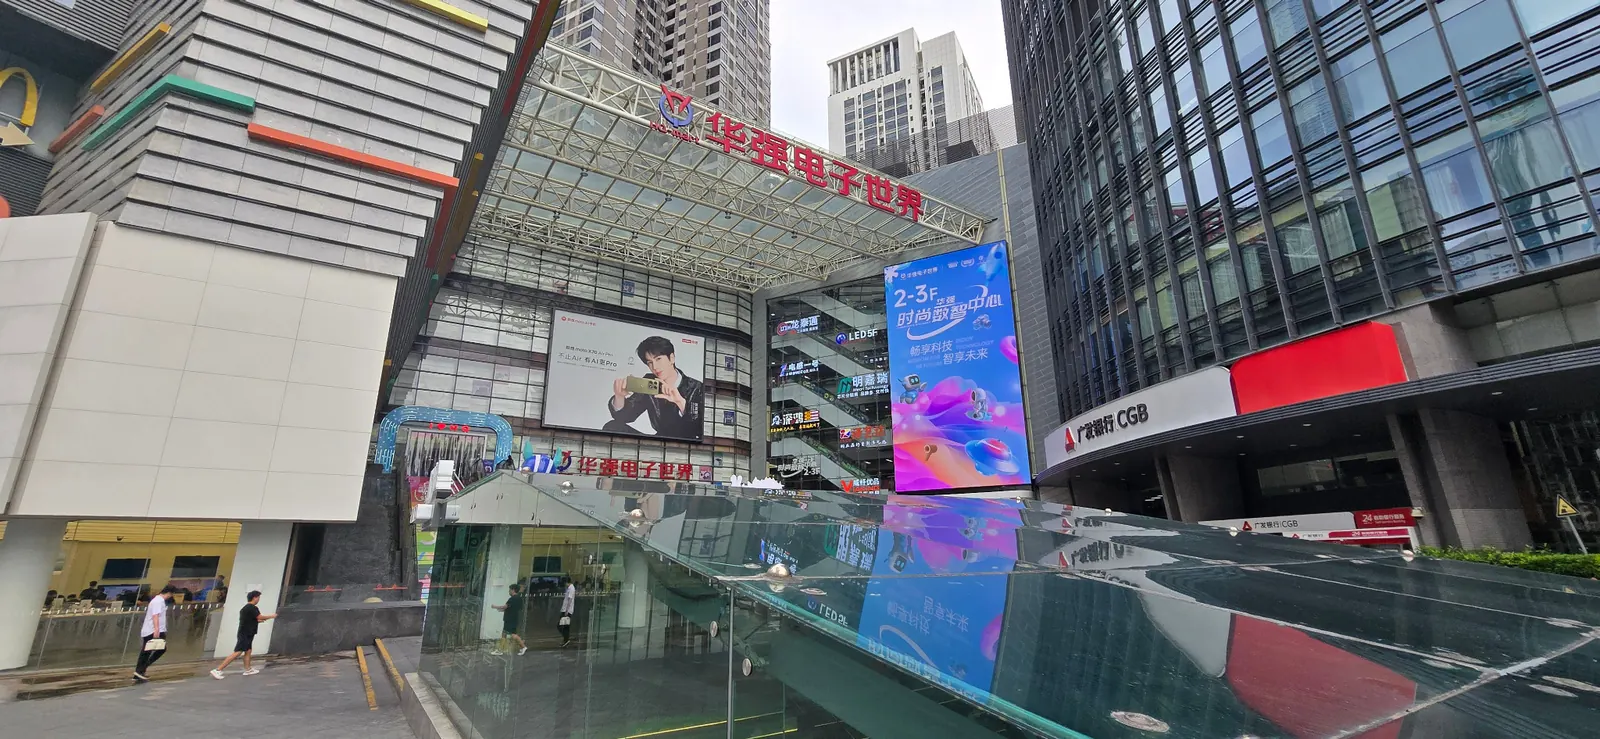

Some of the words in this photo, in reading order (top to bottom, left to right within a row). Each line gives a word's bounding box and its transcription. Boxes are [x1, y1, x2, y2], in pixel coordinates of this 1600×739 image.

[706, 112, 924, 222] 华强电子世界
[894, 284, 938, 308] 2-3F
[936, 295, 956, 306] 华强
[897, 293, 1004, 327] 时尚数智中心
[910, 340, 953, 357] 畅享科技
[943, 348, 989, 365] 智享未来
[853, 371, 889, 388] 明嘉瑞
[1077, 414, 1114, 443] 广发银行
[1117, 403, 1149, 429] CGB
[577, 456, 693, 481] 华强电子世界
[804, 467, 820, 476] 2-3F
[1254, 520, 1279, 529] 广发银行
[1282, 520, 1299, 528] CGB
[1362, 514, 1373, 523] 24
